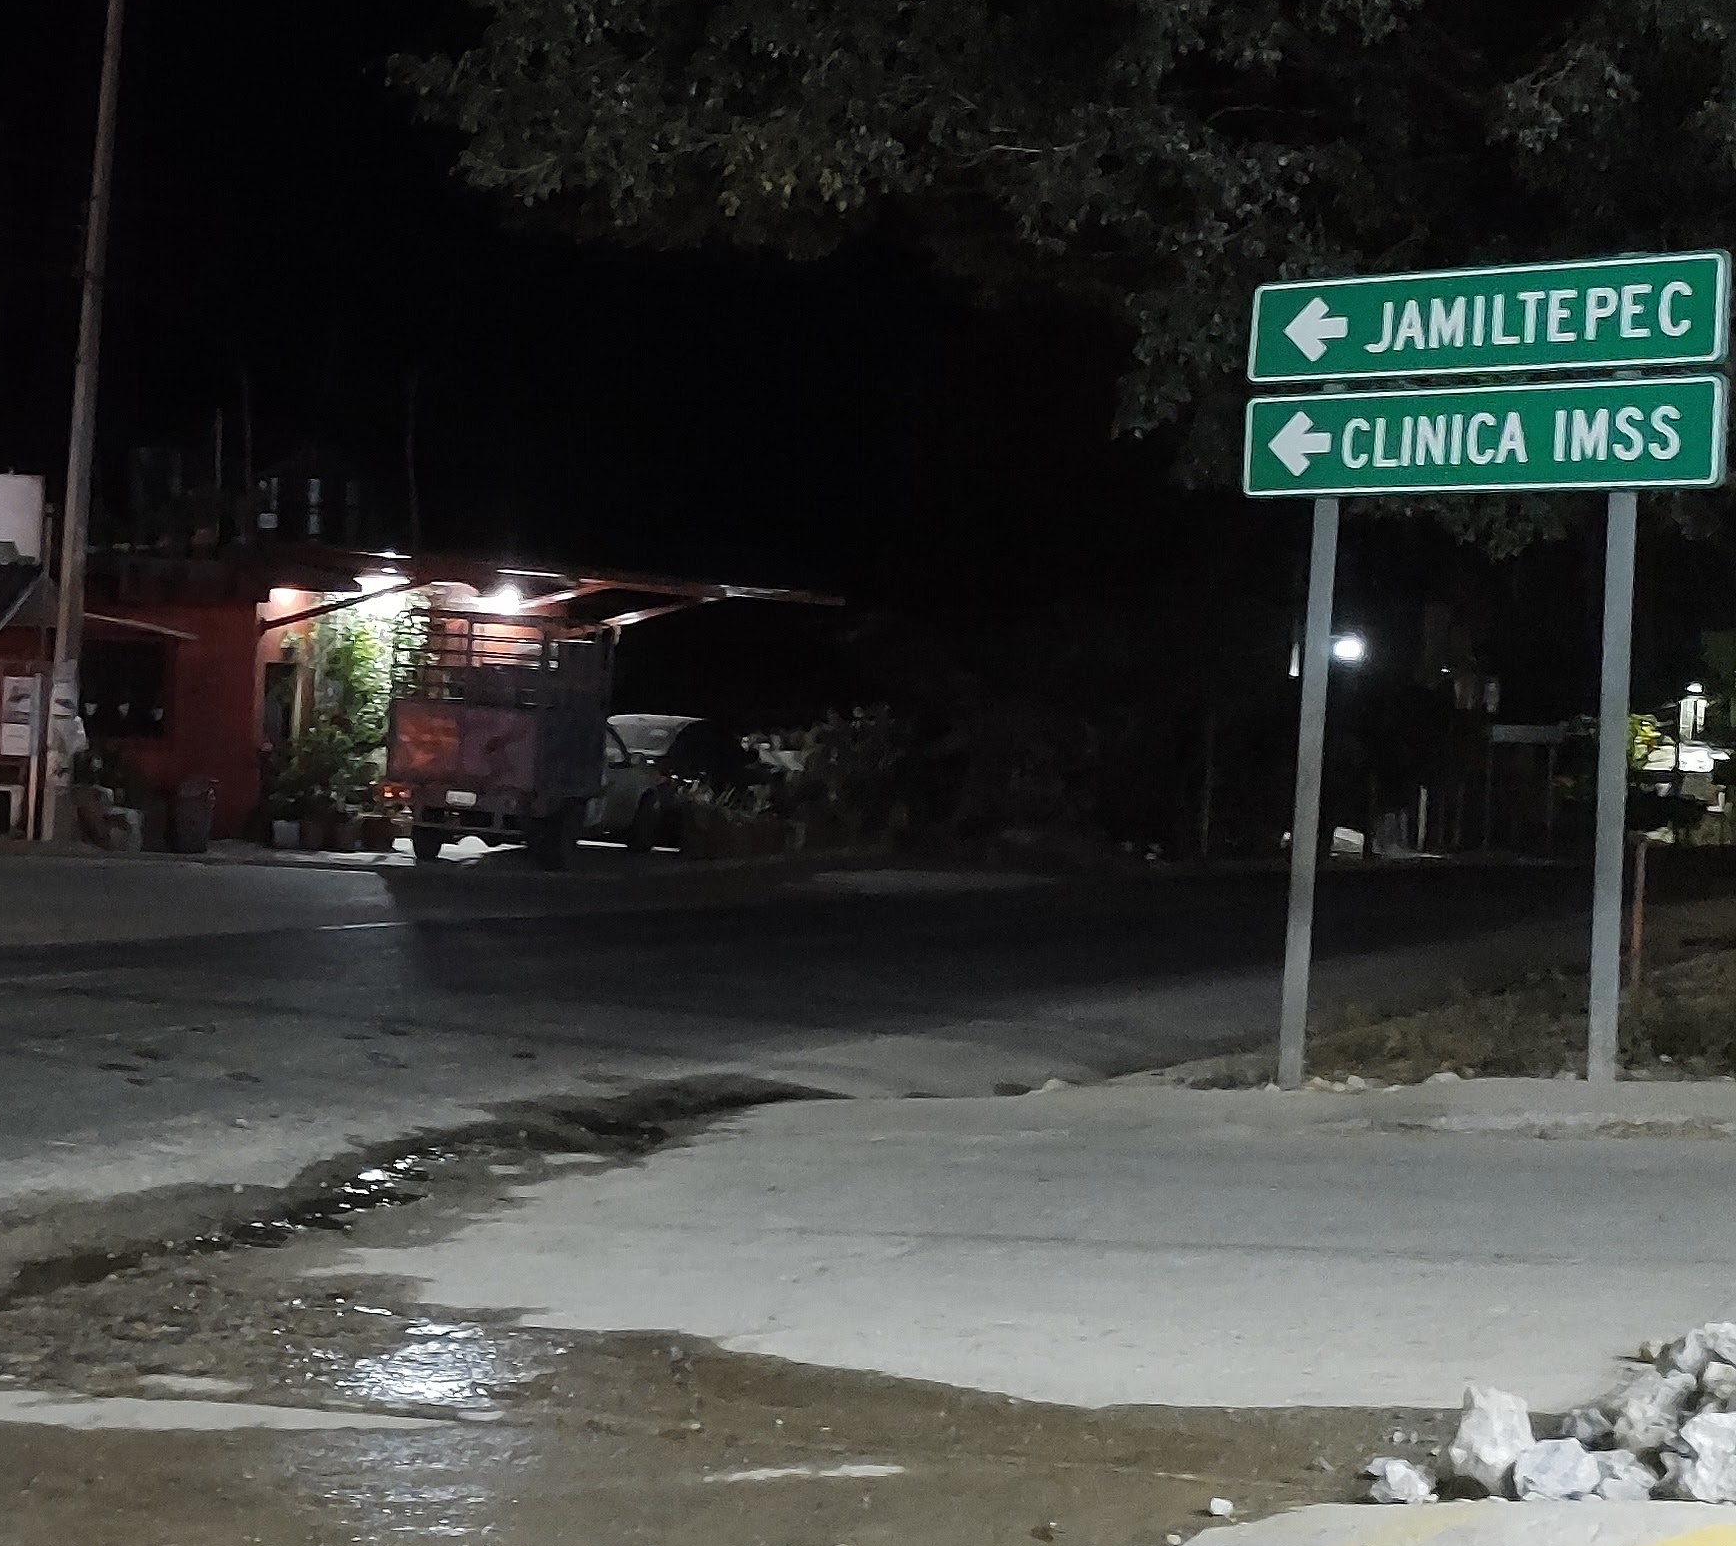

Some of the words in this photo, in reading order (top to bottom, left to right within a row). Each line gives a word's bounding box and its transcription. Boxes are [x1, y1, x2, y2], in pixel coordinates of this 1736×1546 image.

[1364, 281, 1693, 353] JAMILTEPEC
[1341, 410, 1528, 469] CLINICA
[1553, 405, 1682, 462] IMSS
